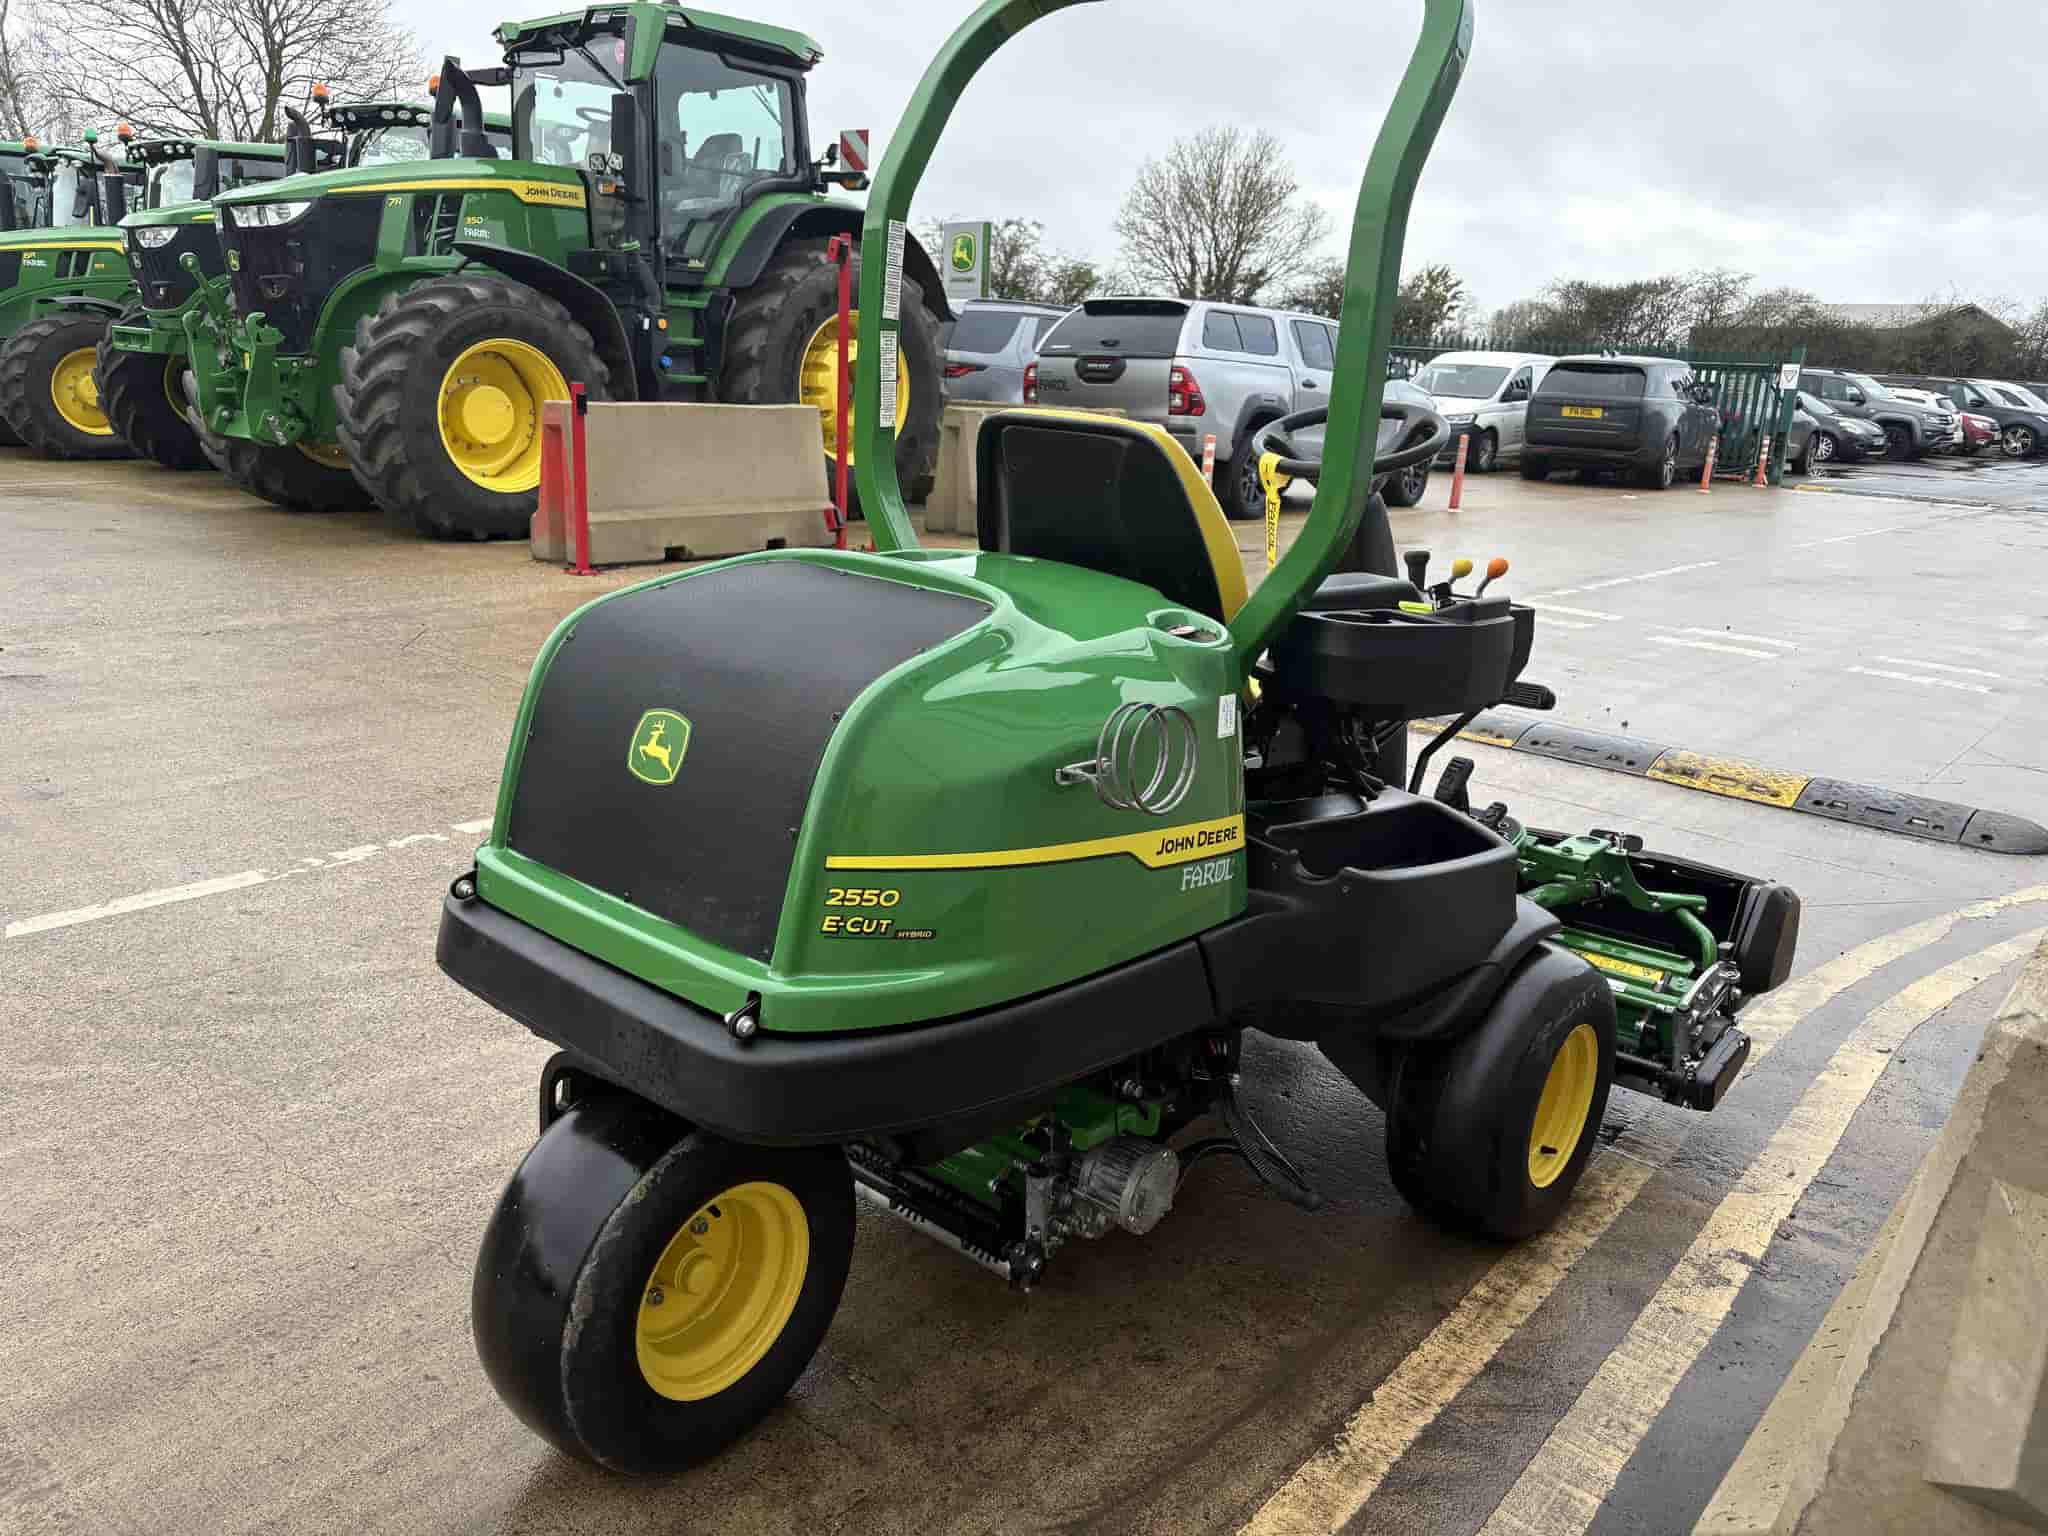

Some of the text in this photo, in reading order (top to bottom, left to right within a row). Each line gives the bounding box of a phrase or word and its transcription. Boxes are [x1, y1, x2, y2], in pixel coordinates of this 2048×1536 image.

[524, 186, 580, 200] JOHN DEERE
[1156, 826, 1238, 856] JOHN DEERE
[1180, 858, 1233, 892] FAROL
[825, 887, 902, 907] 2550
